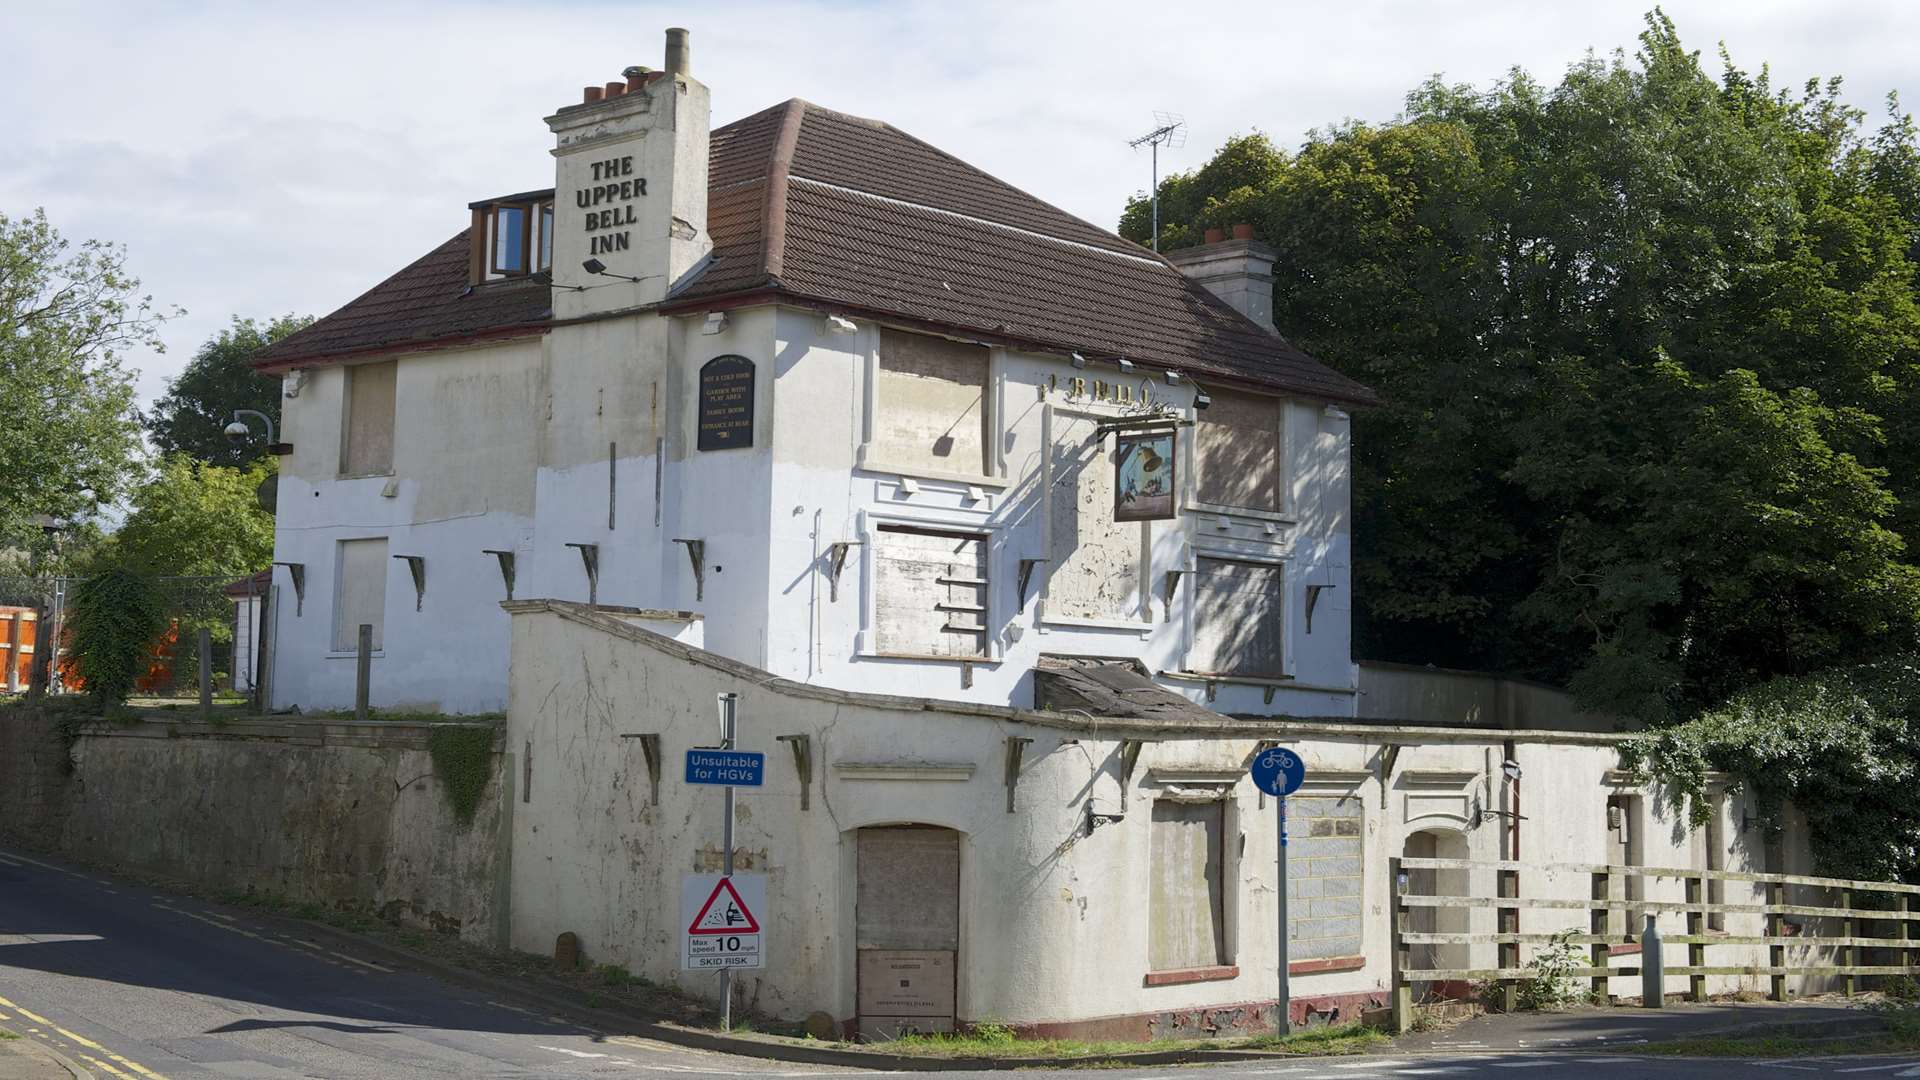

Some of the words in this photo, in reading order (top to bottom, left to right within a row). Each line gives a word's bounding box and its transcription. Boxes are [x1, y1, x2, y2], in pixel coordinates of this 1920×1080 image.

[590, 156, 633, 180] THE
[576, 178, 647, 208] UPPER
[585, 205, 637, 231] BELL
[590, 231, 630, 255] INN
[691, 755, 759, 768] Unsuitable
[695, 767, 712, 779] for
[718, 769, 753, 781] HGVs
[716, 936, 740, 952] 10
[699, 958, 722, 966] SKID
[725, 957, 748, 965] RISK
